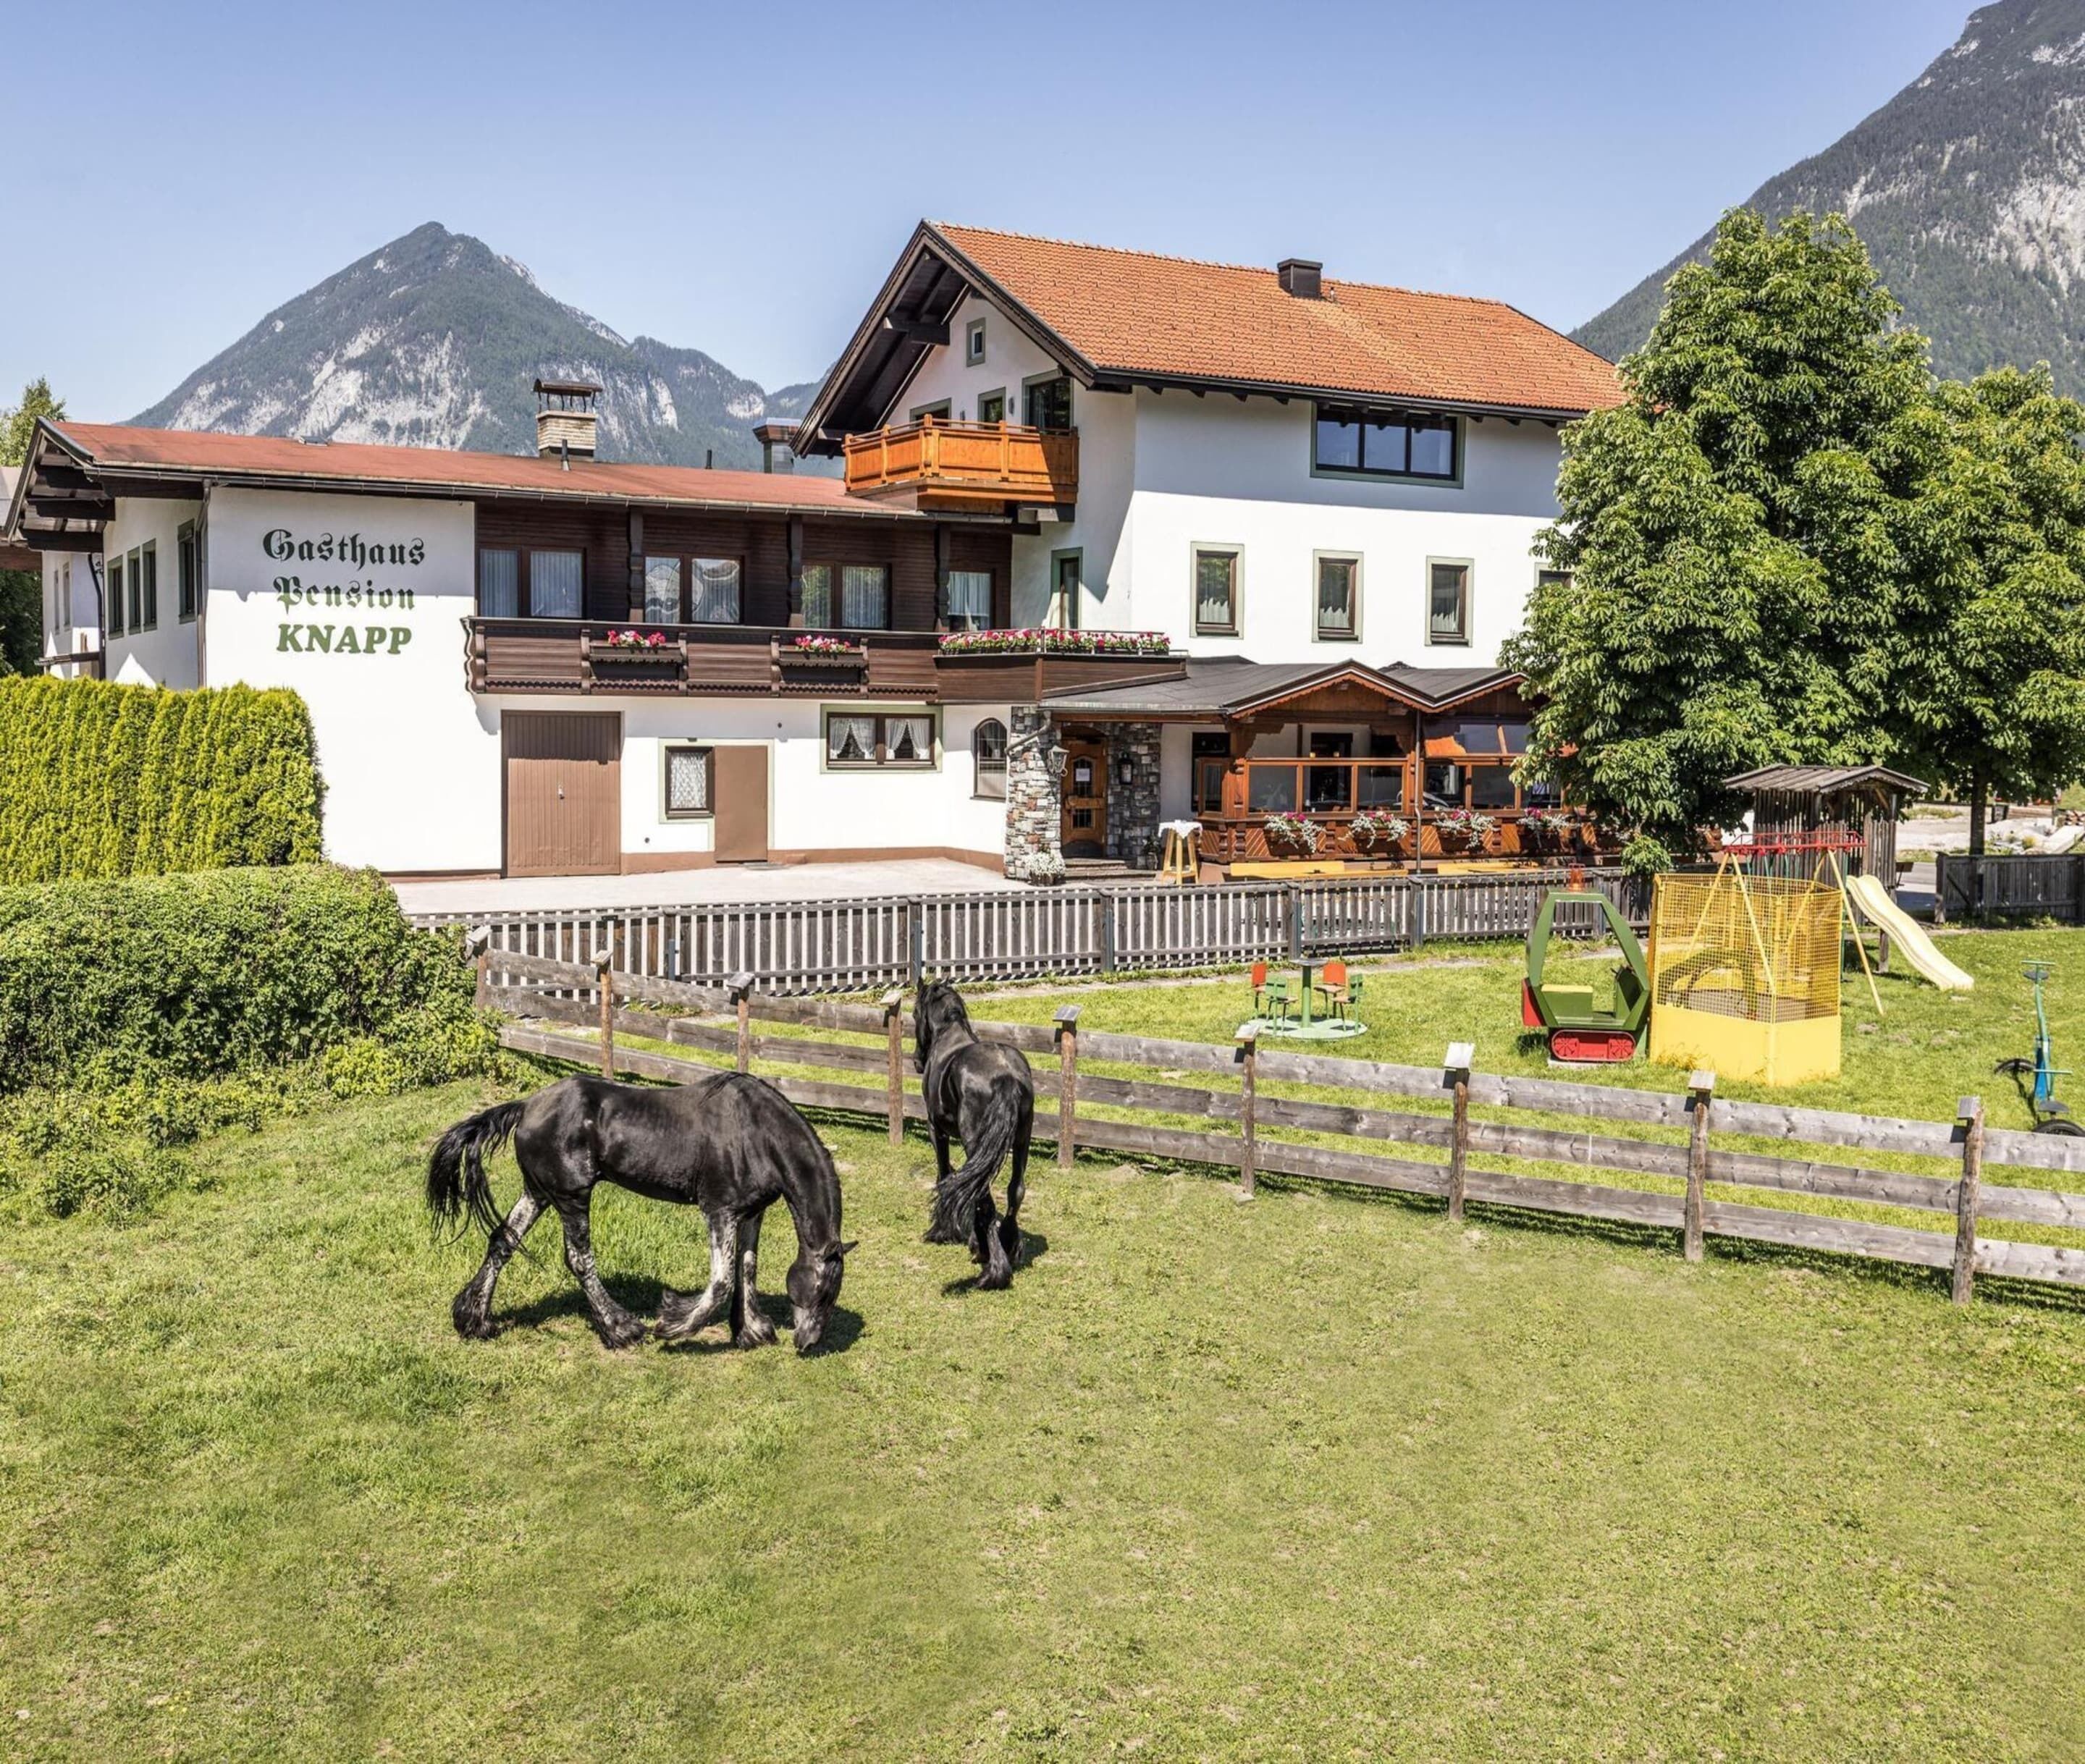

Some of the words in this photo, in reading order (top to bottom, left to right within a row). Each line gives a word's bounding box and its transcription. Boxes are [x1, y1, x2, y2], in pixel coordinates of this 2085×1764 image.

[263, 528, 425, 570] Gasthaus
[273, 576, 415, 615] Pension
[277, 624, 412, 654] KNAPP
